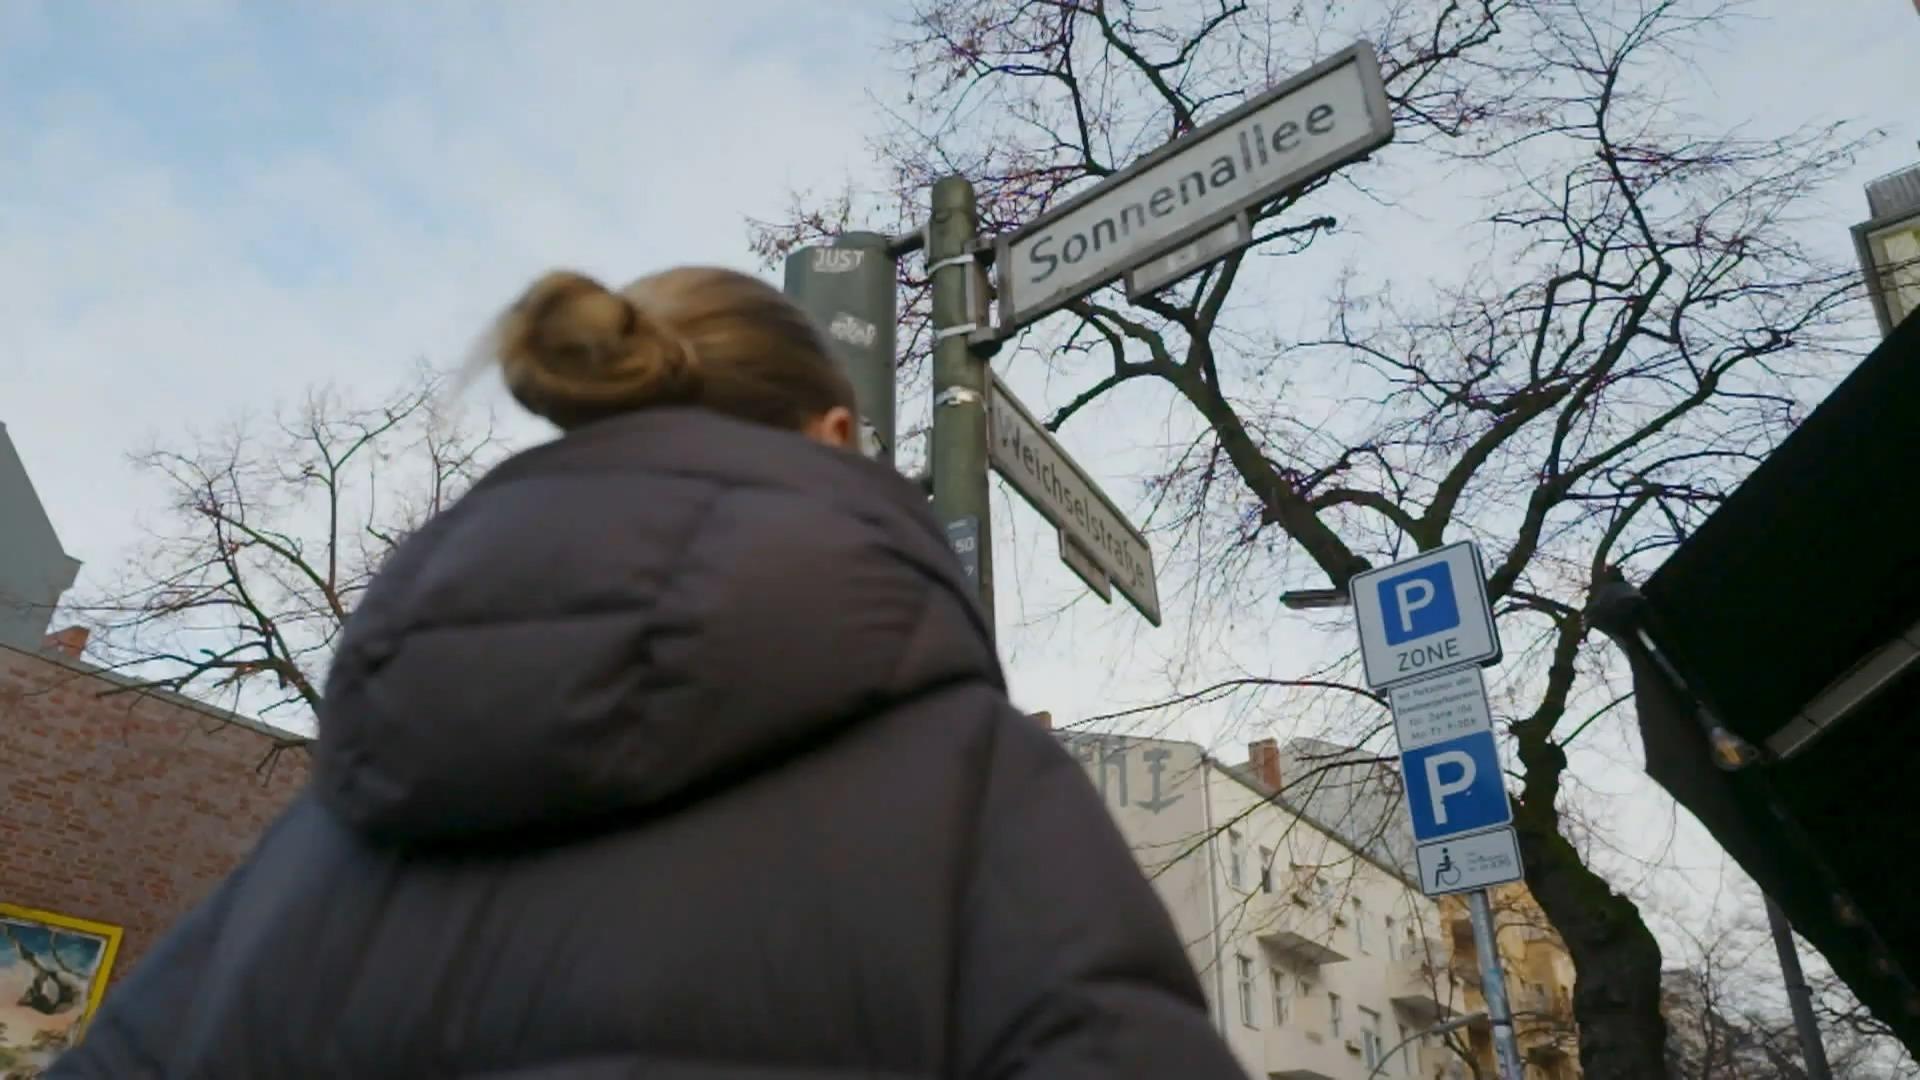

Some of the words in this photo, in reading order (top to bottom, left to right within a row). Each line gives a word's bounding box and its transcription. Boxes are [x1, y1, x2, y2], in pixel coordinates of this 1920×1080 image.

[1029, 102, 1335, 283] Sonnenallee
[1395, 578, 1435, 632] P
[1398, 638, 1460, 672] ZONE
[1424, 750, 1477, 826] P
